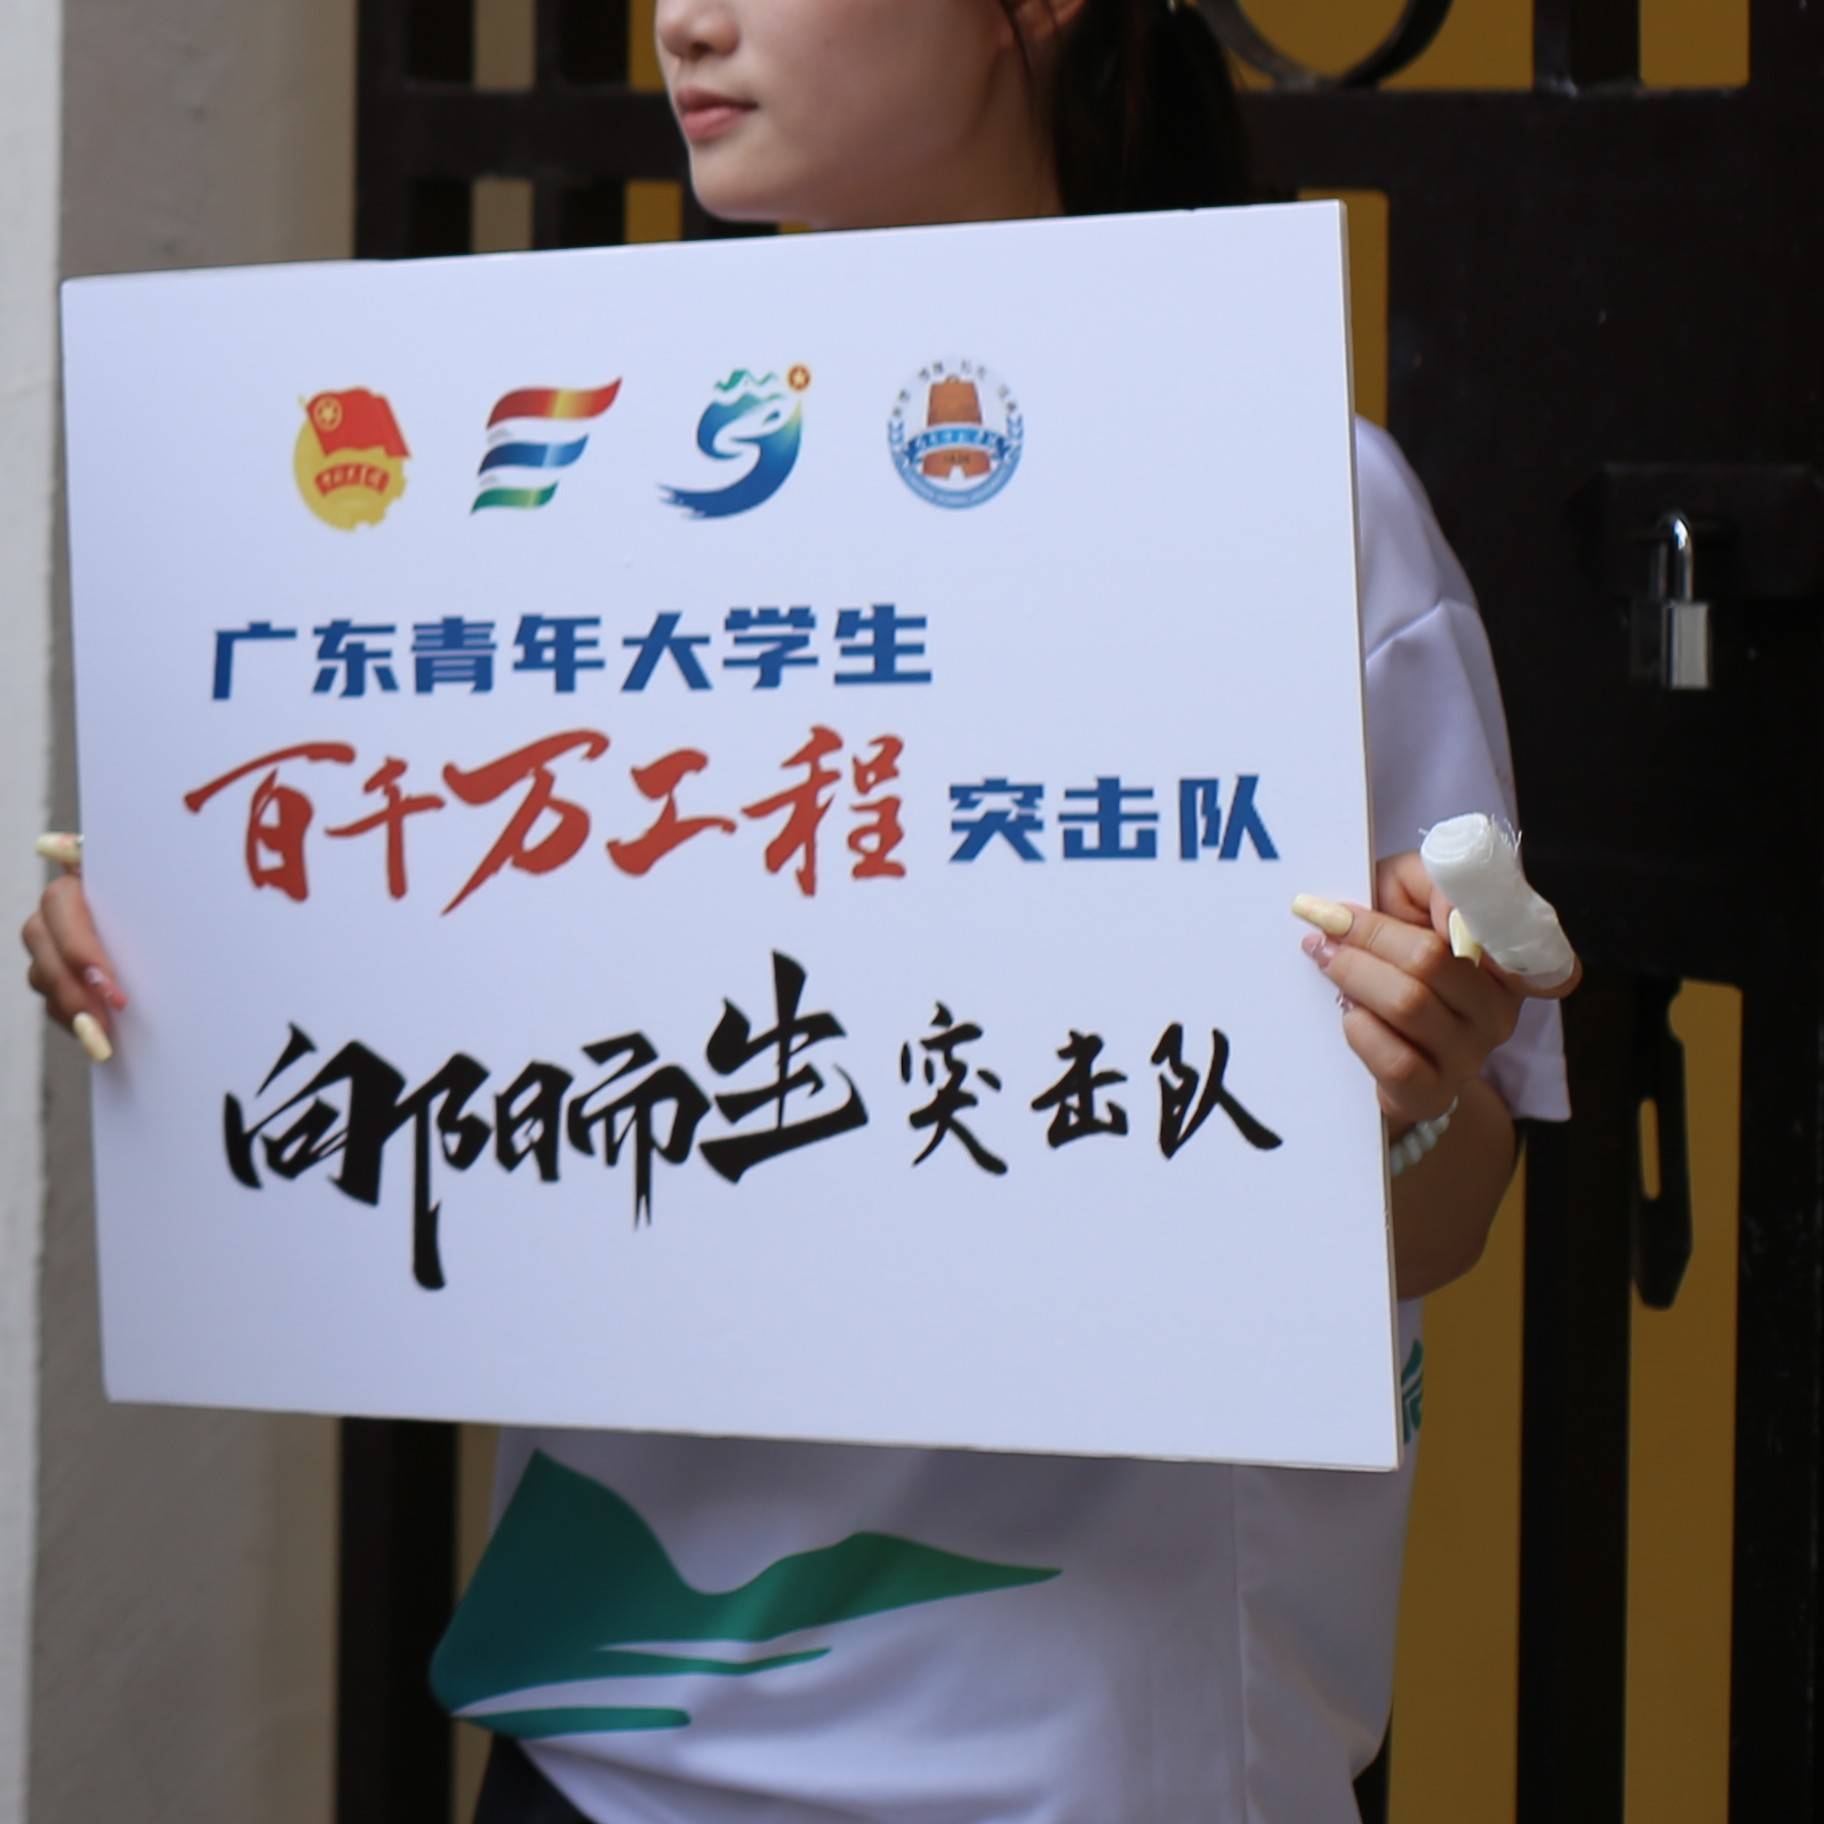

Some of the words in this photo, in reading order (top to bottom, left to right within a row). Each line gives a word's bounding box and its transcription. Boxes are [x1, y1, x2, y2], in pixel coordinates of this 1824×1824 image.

[212, 604, 933, 701] 广东青年大学生
[183, 726, 906, 915] 百千万工程
[949, 774, 1280, 863] 突击队
[222, 951, 869, 1292] 向阳而生
[900, 1002, 1283, 1176] 突击队
